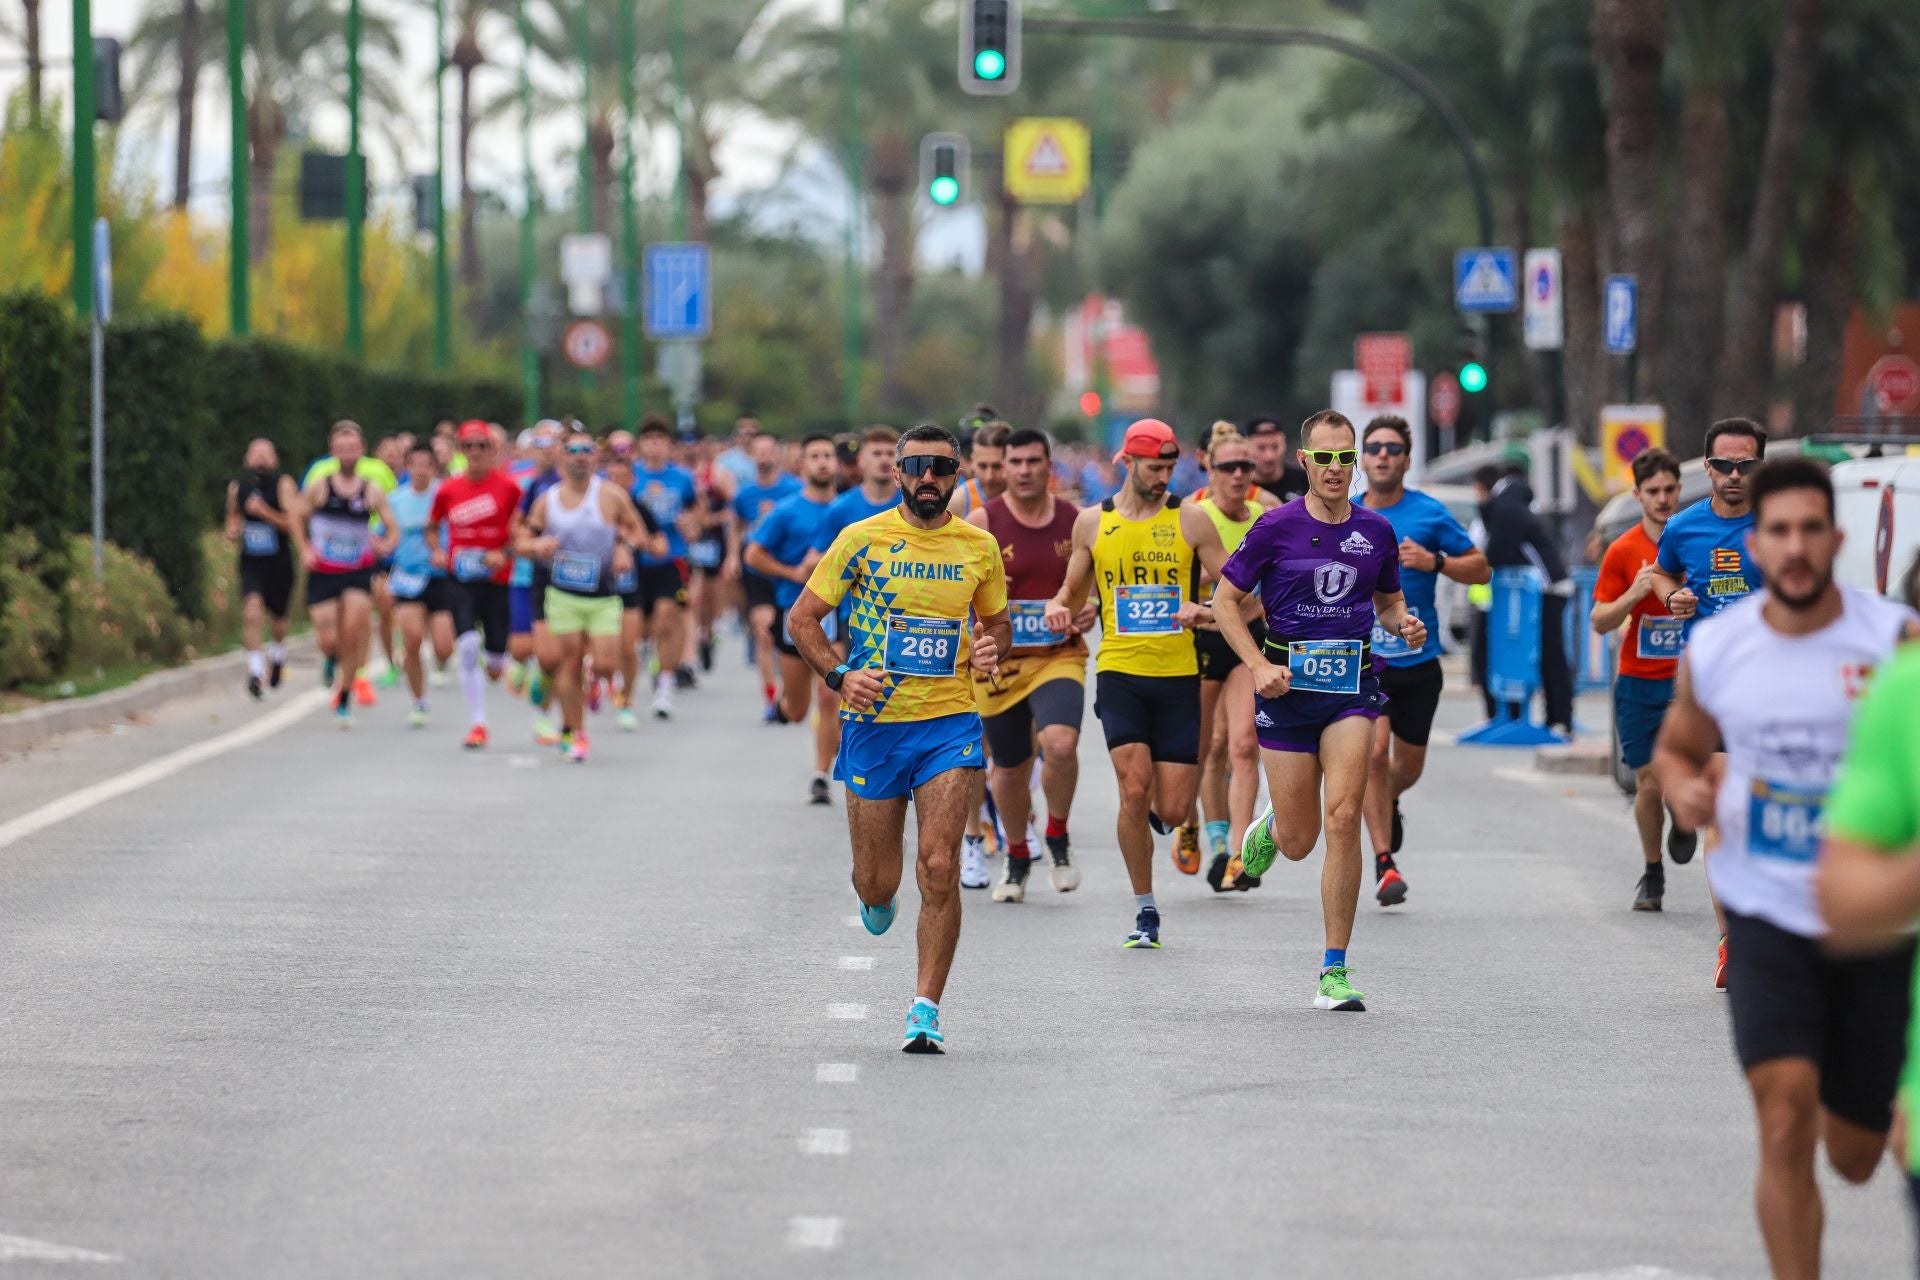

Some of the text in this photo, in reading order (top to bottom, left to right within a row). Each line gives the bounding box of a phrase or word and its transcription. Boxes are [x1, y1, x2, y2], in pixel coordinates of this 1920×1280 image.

[1133, 551, 1180, 563] GLOBAL
[890, 561, 964, 581] UKRAINE
[1128, 601, 1169, 619] 322
[901, 636, 948, 658] 268
[1303, 658, 1347, 677] 053
